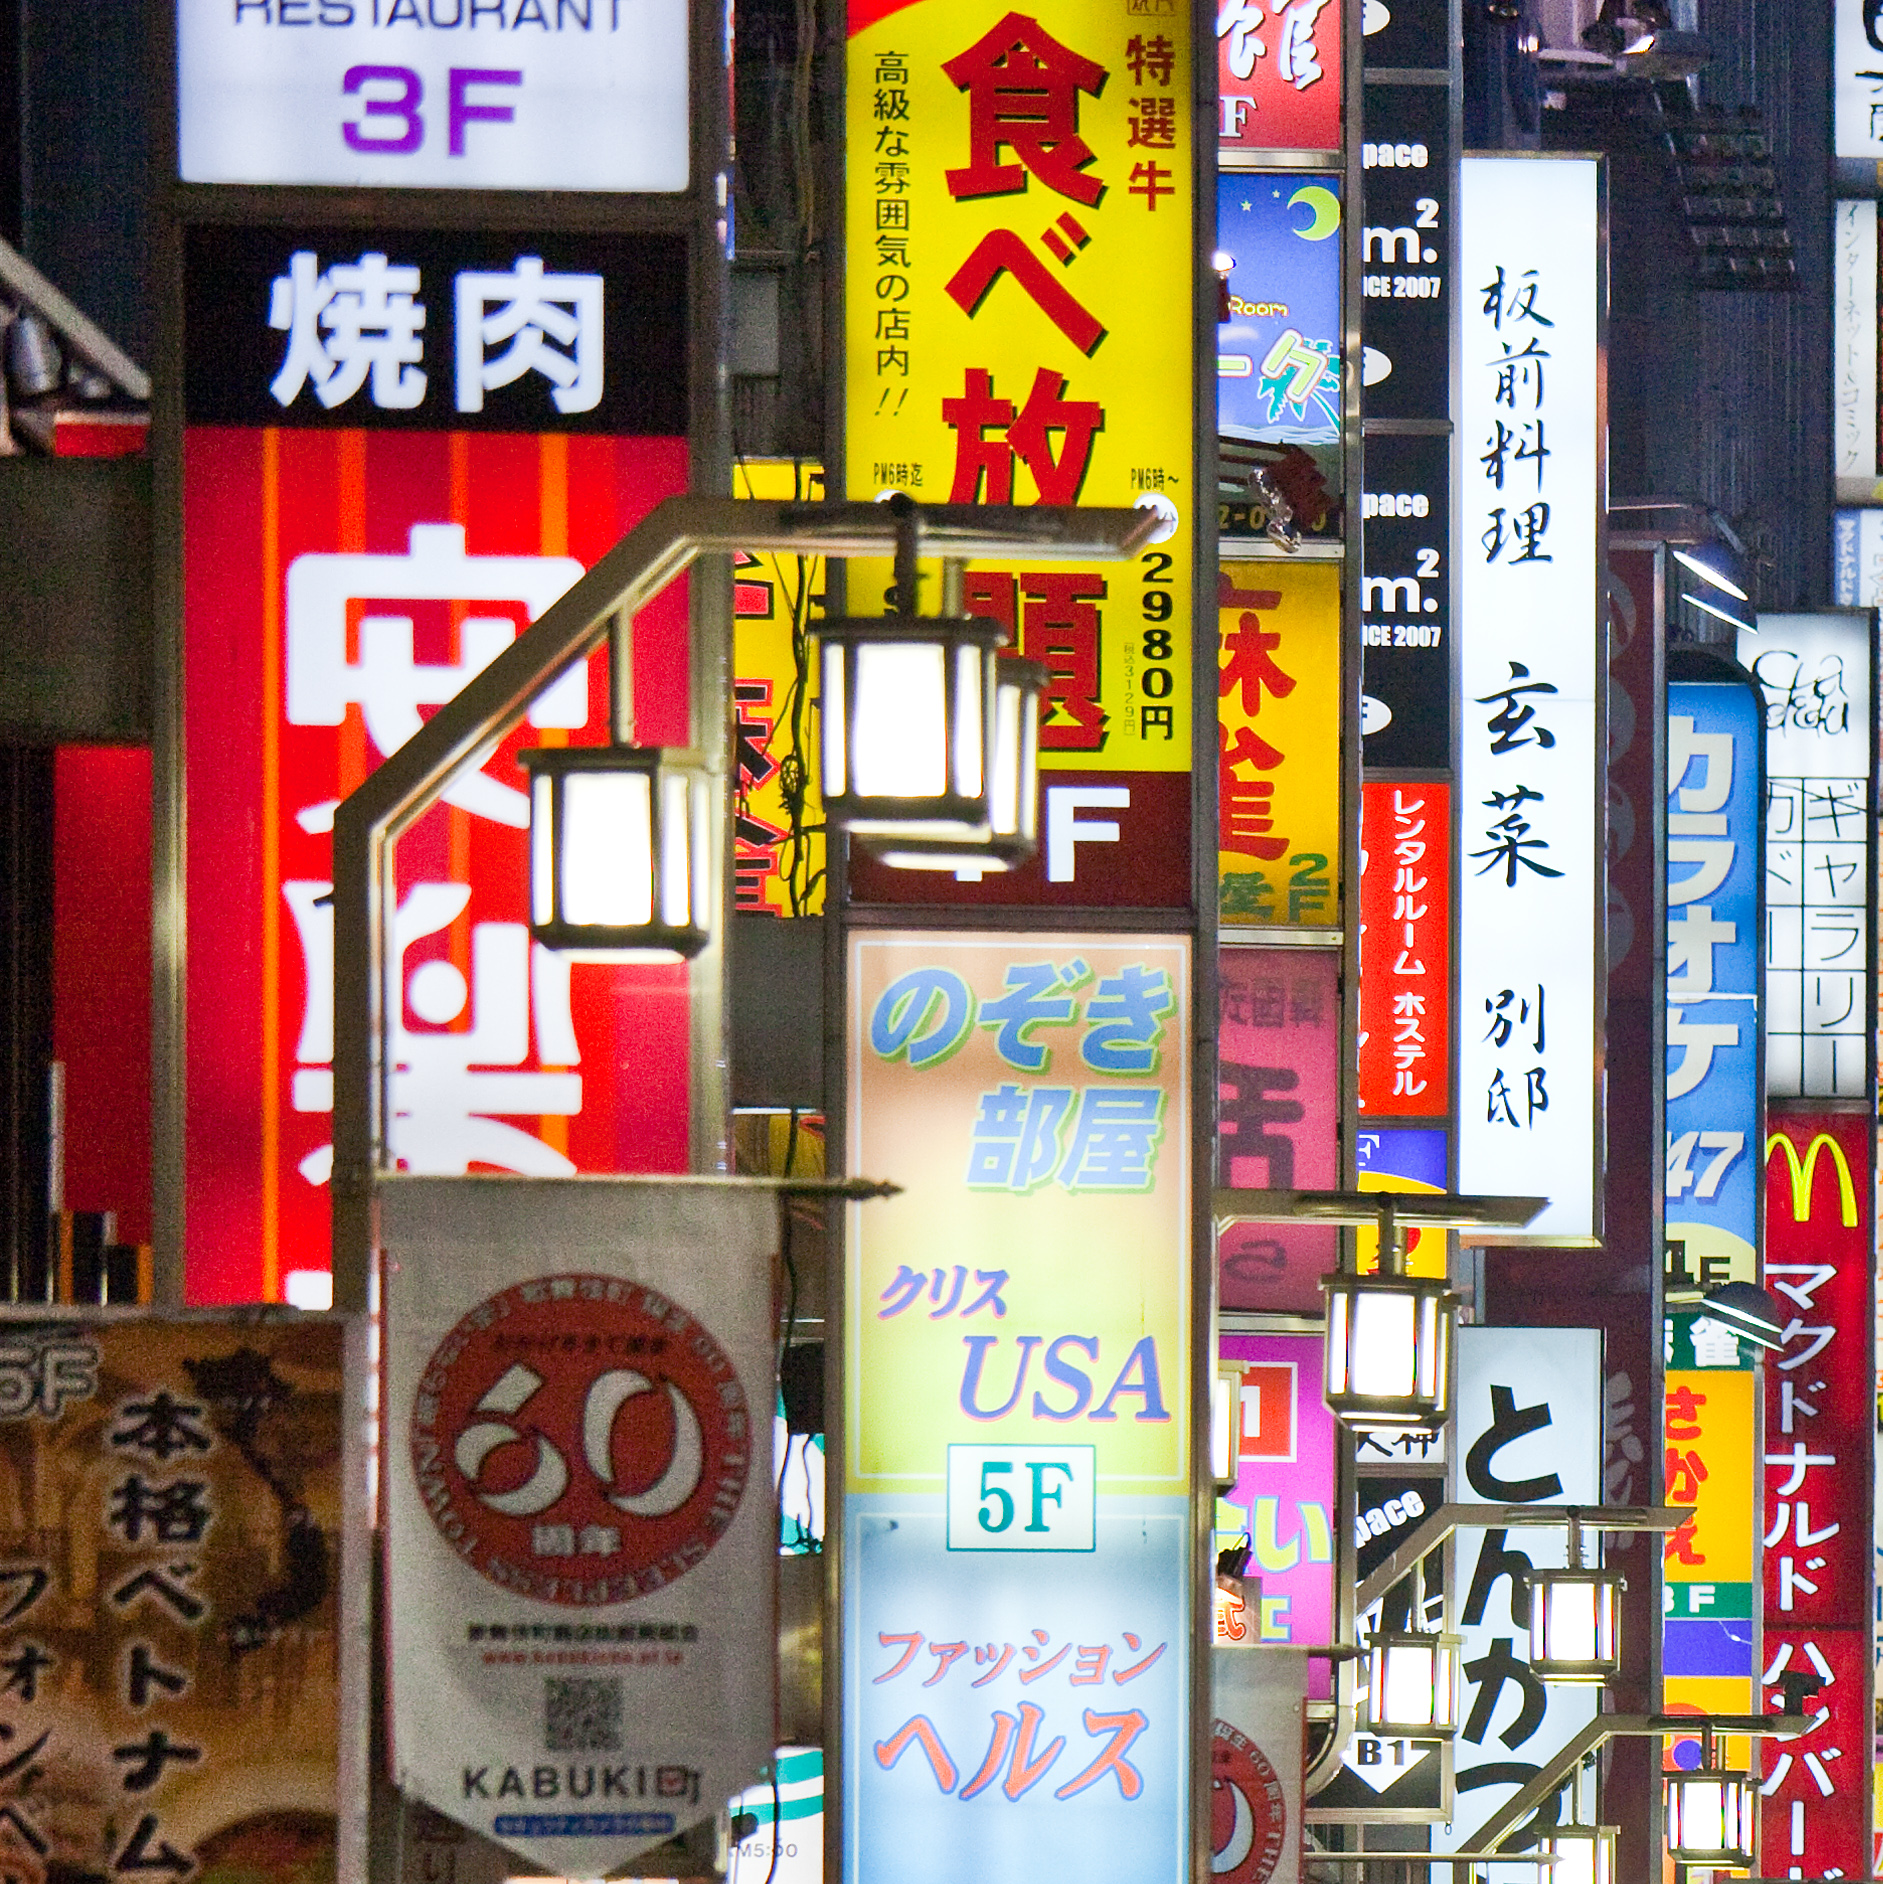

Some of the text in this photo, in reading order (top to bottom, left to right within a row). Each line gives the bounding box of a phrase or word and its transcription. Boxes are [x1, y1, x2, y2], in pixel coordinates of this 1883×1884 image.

[342, 64, 525, 157] 3F
[1125, 34, 1176, 212] 特選牛
[873, 50, 911, 417] 高級な雰囲気の店内!!
[1393, 277, 1441, 298] 2007
[268, 250, 606, 414] 焼肉
[873, 462, 924, 488] PM6時迄
[1140, 552, 1175, 742] 2980円
[1393, 626, 1441, 647] 2007
[1466, 265, 1567, 1132] 板前料理 玄菜 別邸
[1390, 790, 1427, 1097] レンタルルーム ホステル
[1808, 783, 1864, 1095] ギャラリー
[868, 957, 1178, 1078] のぞき
[965, 1082, 1168, 1196] 部屋
[877, 1265, 1011, 1322] クリス
[957, 1333, 1173, 1424] USA
[454, 1363, 704, 1518] 60
[1764, 1262, 1840, 1614] マクドナルド
[976, 1460, 1074, 1536] 5F
[875, 1629, 1168, 1688] ファッション
[873, 1701, 1150, 1803] ヘルス
[1356, 1739, 1405, 1766] B1
